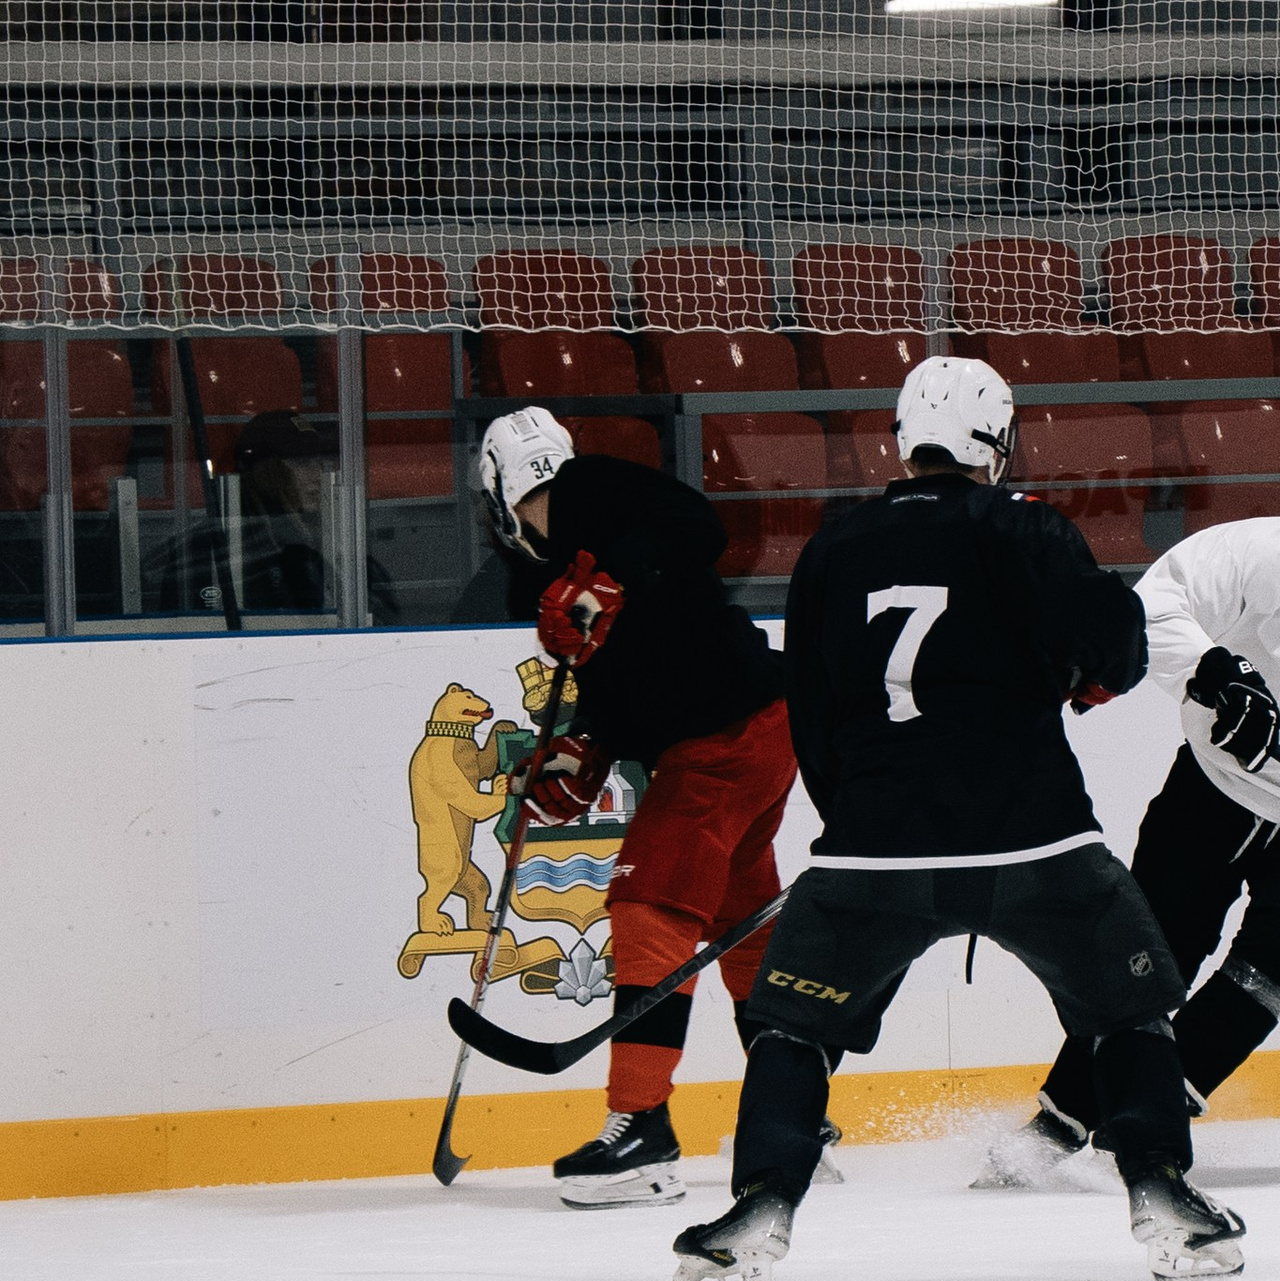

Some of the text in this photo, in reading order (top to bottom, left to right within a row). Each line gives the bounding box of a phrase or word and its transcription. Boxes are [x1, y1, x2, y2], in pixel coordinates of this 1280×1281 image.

[530, 457, 555, 479] 34
[867, 585, 948, 722] 7
[767, 969, 851, 1004] CCM
